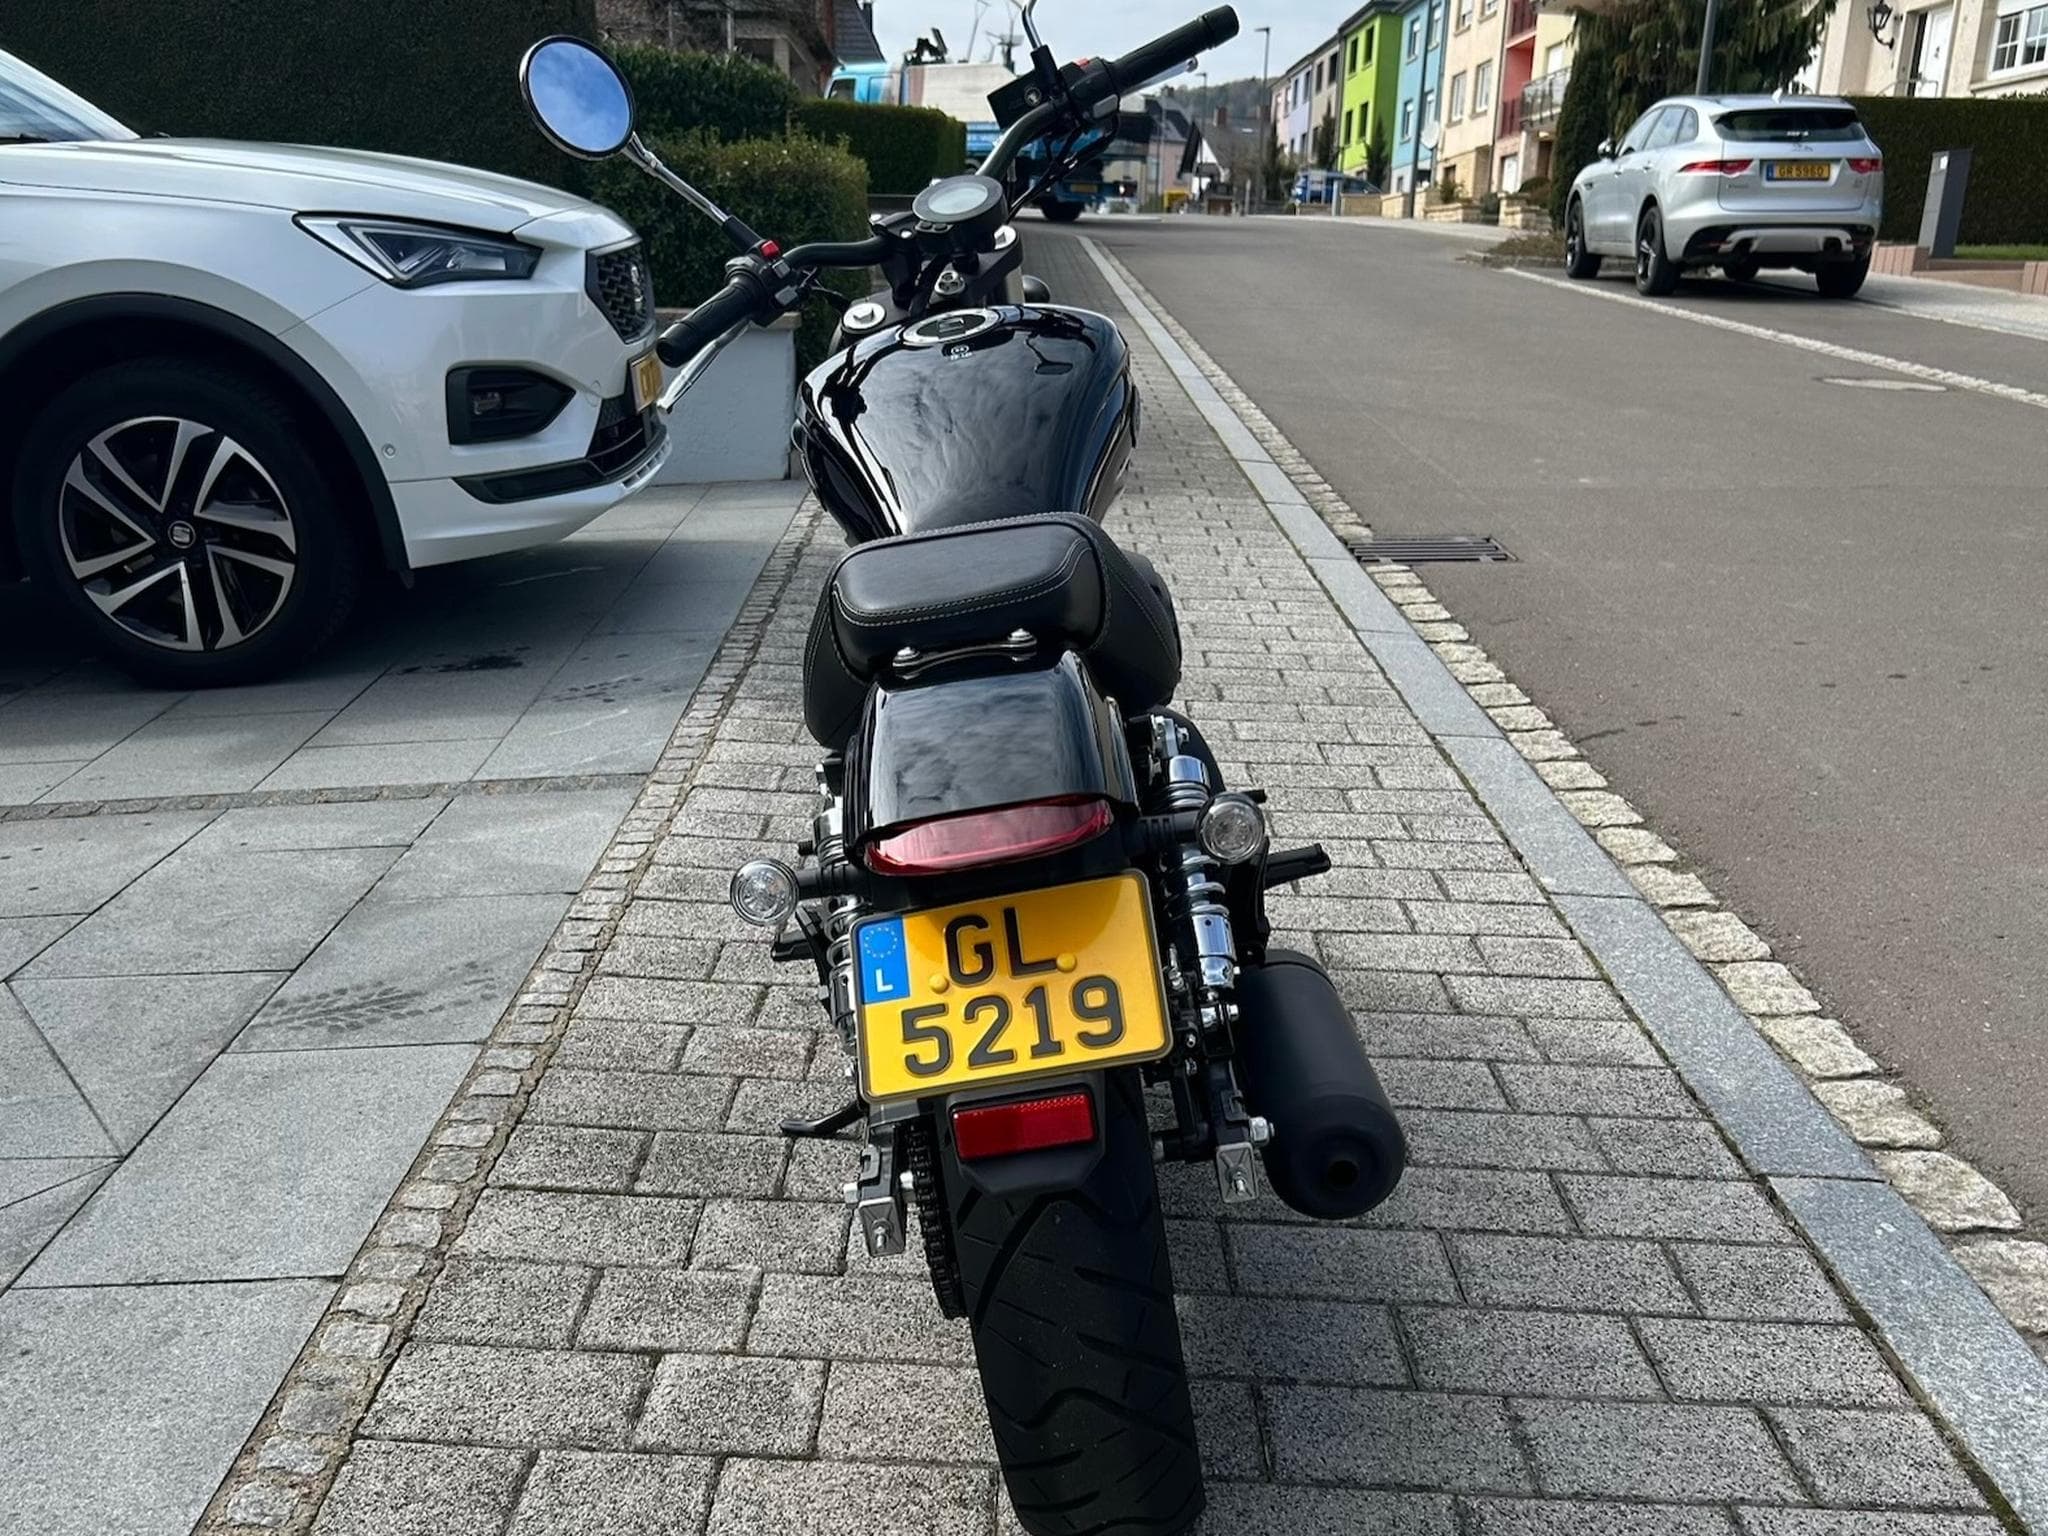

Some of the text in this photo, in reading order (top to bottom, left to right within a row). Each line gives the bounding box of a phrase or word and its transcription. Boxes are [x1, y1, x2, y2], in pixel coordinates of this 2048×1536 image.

[875, 968, 893, 993] L
[944, 907, 1057, 986] GL
[901, 975, 1125, 1077] 5219
